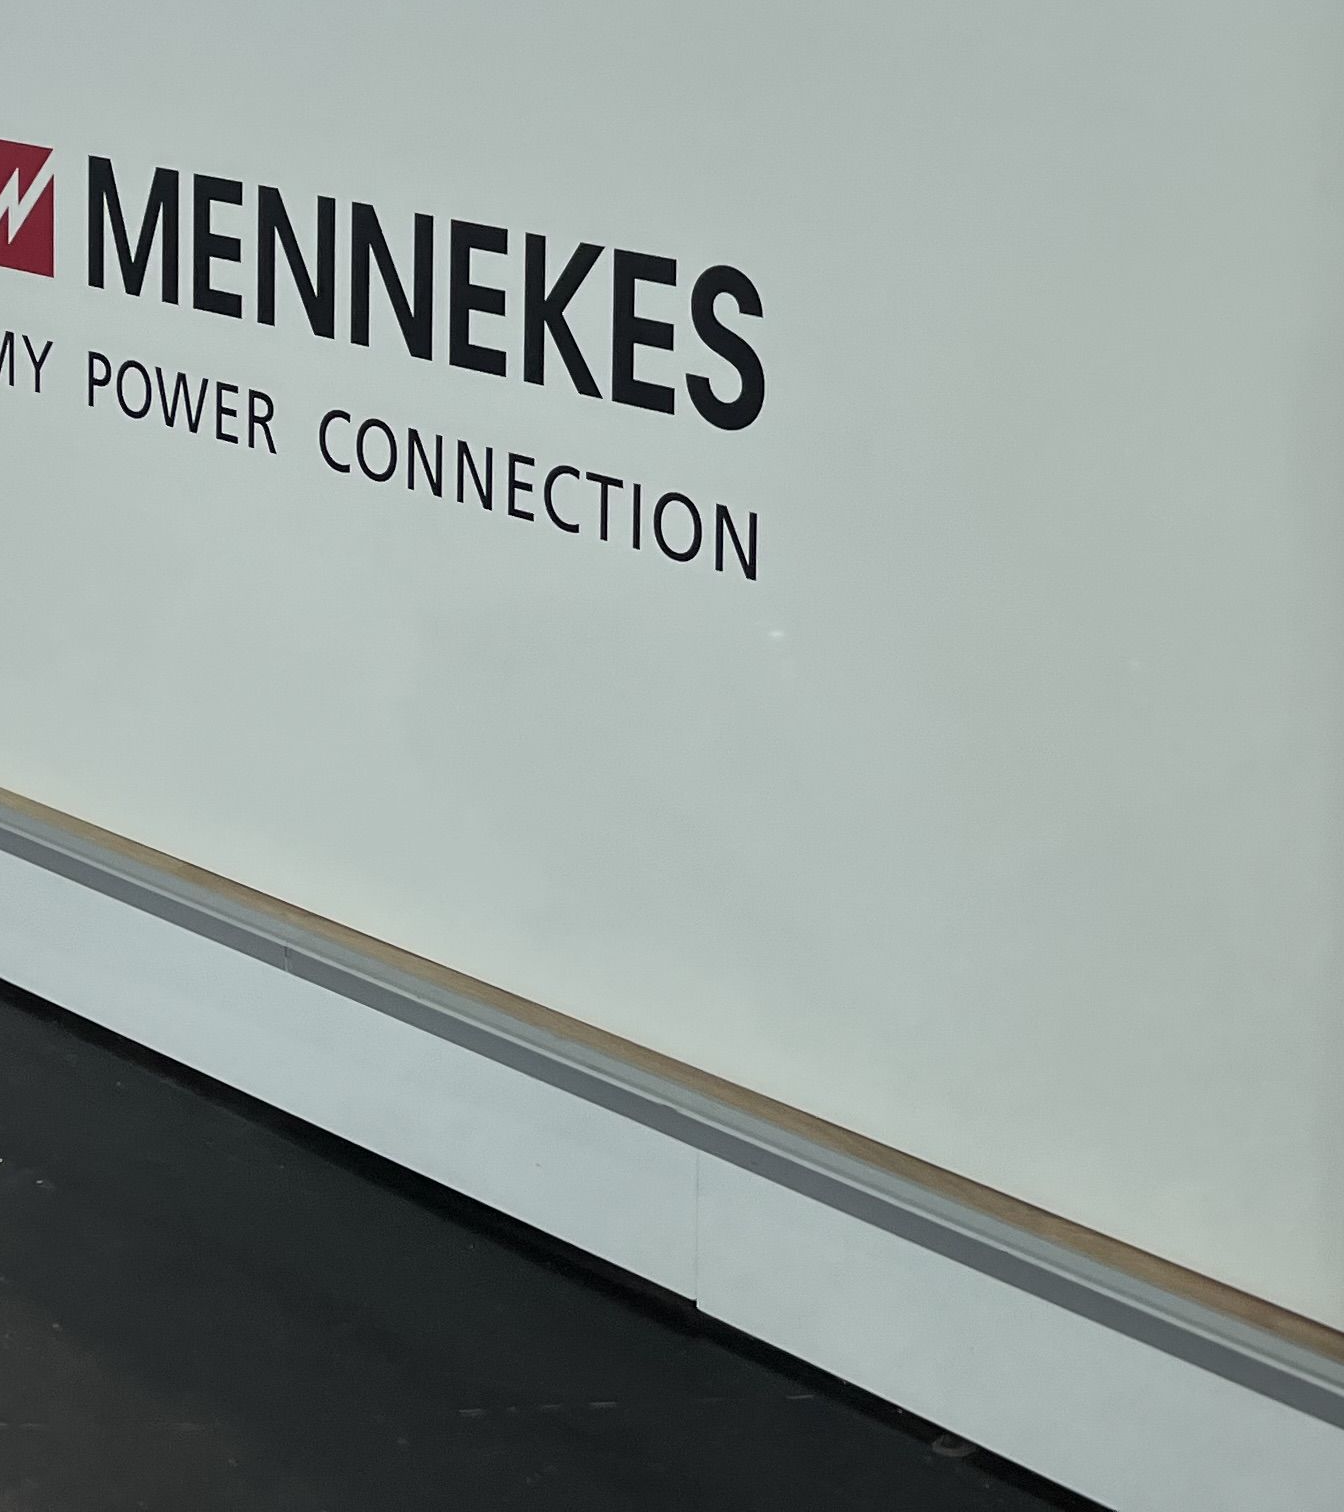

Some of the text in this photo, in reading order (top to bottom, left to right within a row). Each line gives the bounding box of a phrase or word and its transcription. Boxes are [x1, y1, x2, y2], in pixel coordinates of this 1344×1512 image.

[88, 155, 766, 431] MENNEKES
[88, 351, 277, 454] POWER
[319, 409, 758, 580] CONNECTION
